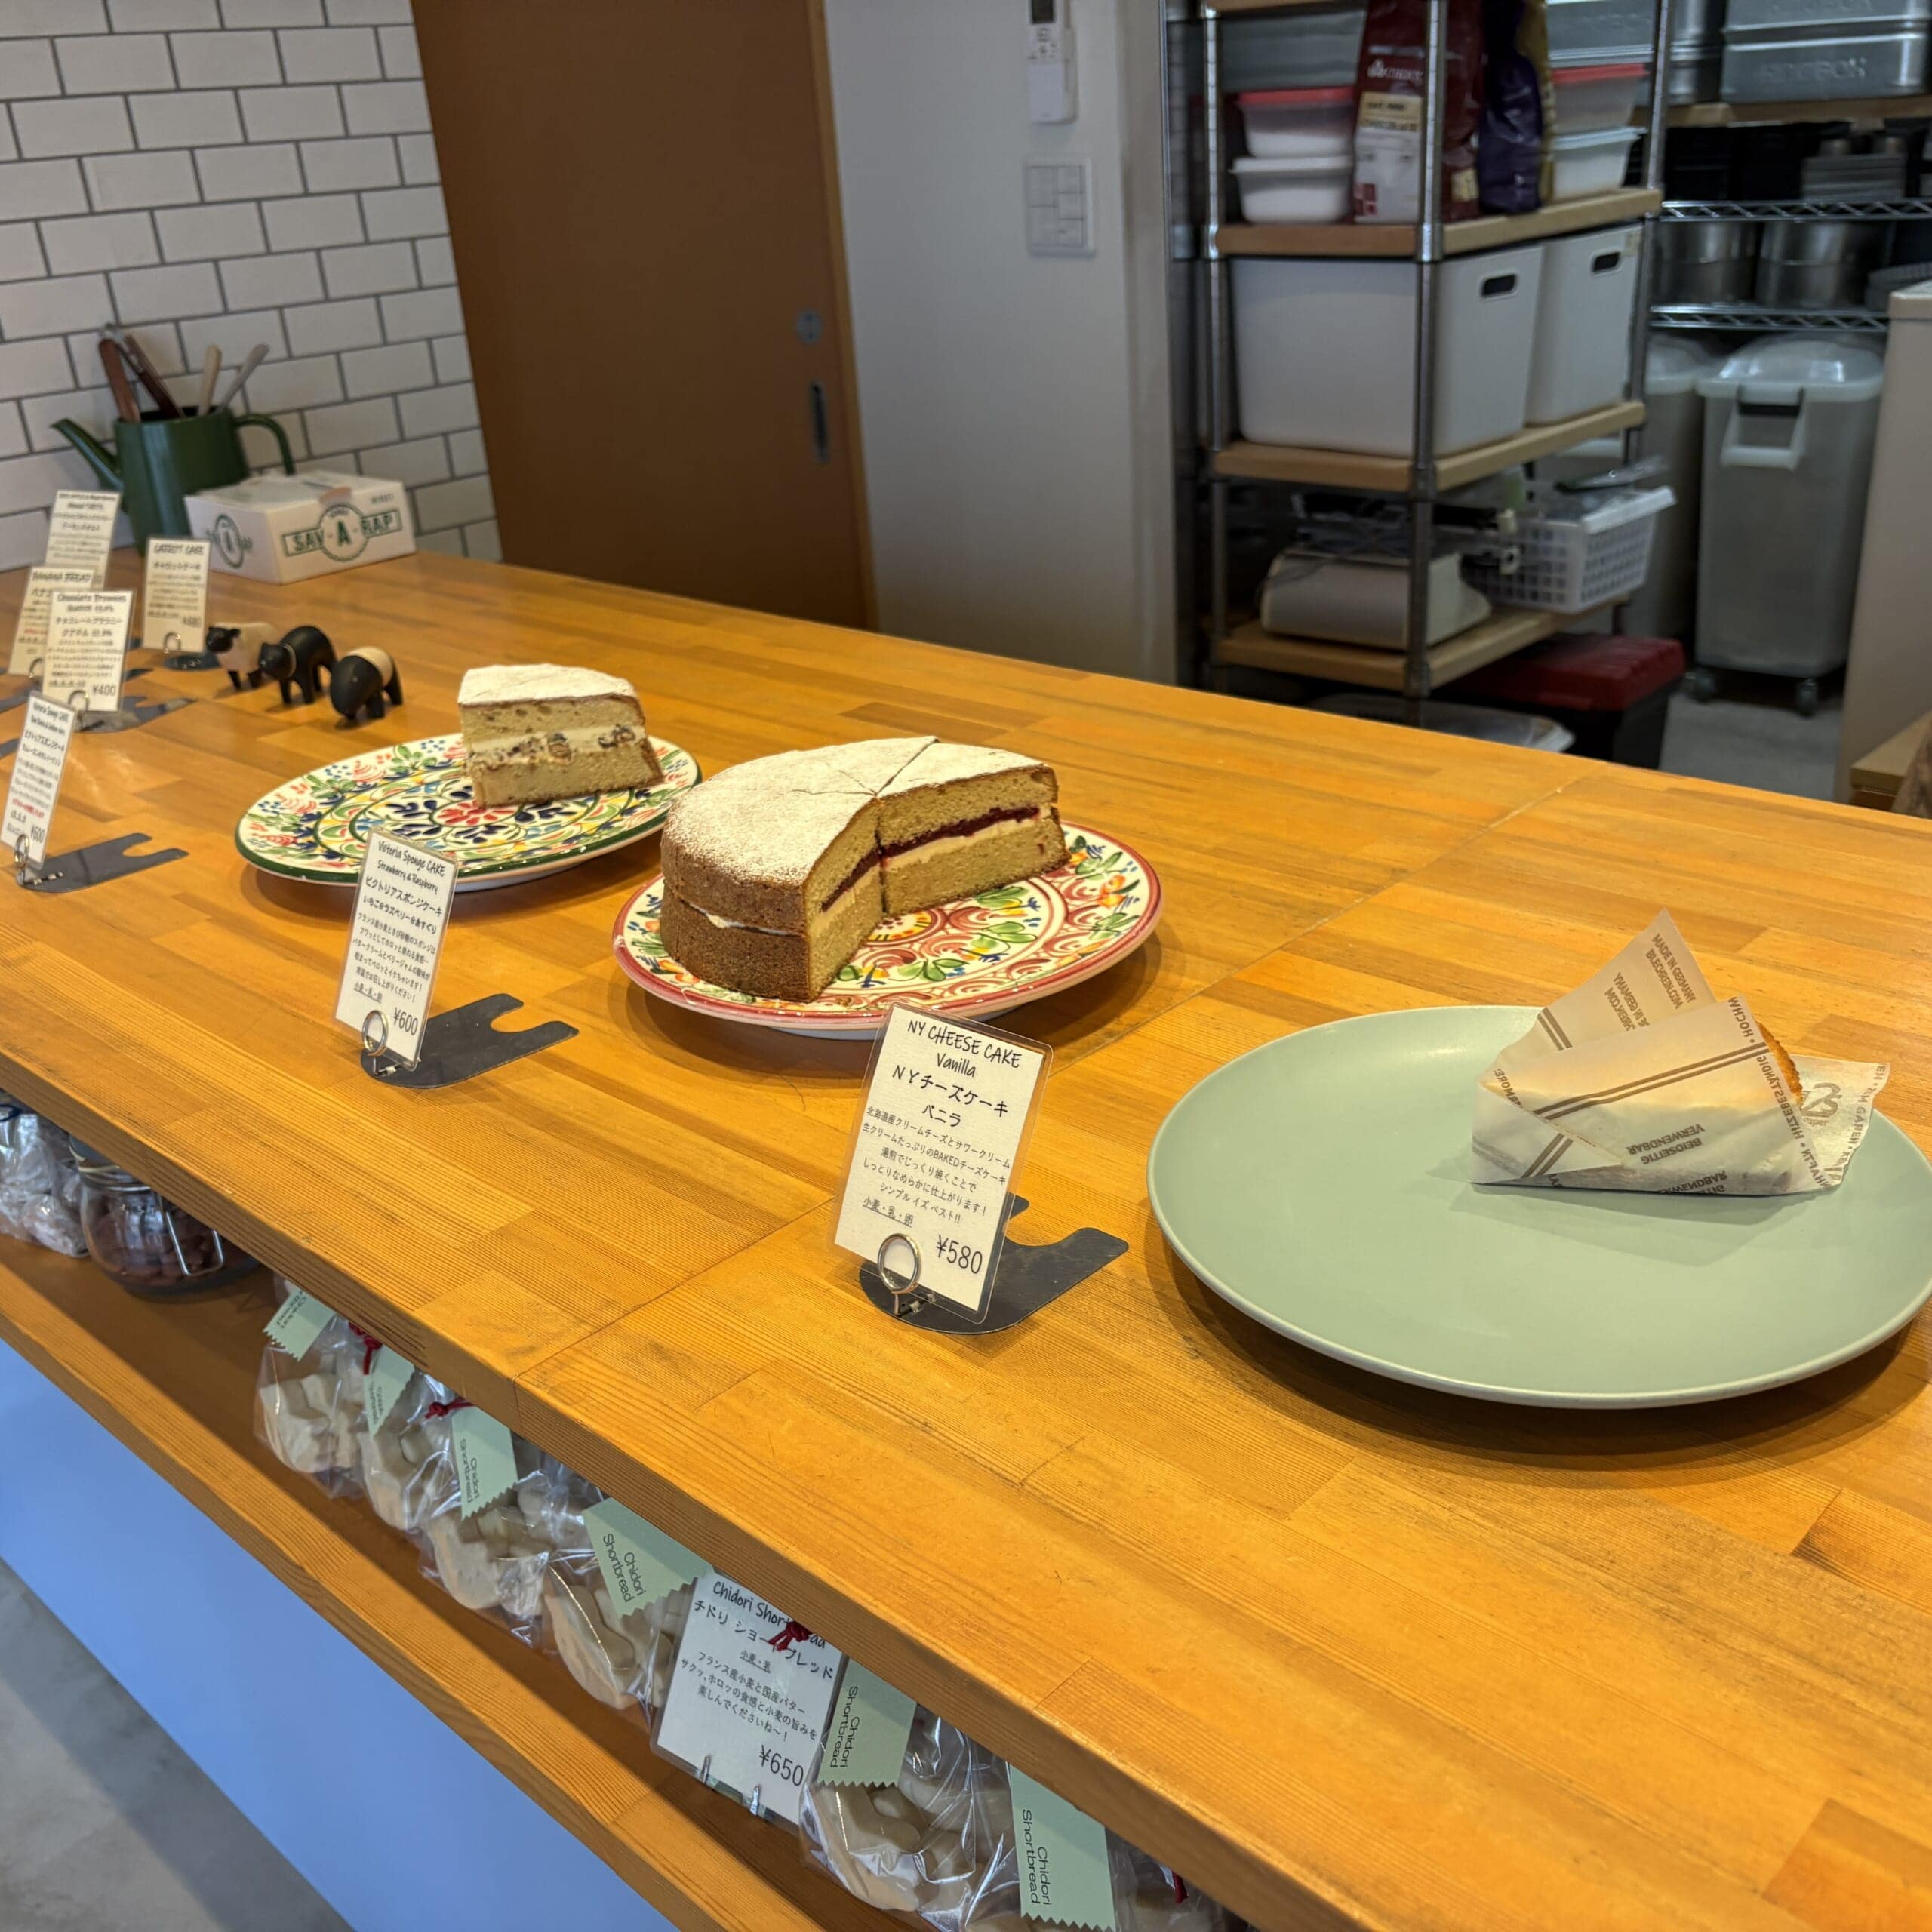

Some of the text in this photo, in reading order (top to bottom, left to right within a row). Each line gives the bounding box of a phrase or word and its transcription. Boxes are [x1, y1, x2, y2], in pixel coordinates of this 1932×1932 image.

[337, 521, 351, 546] A
[377, 860, 405, 878] Strawberry
[412, 875, 438, 893] Raspberry
[378, 841, 445, 875] Victoria Sponge CAKE
[365, 875, 442, 917] ビクトリアスポンジケーキ
[1652, 934, 1697, 1003] MADE IN GERMANY
[392, 1008, 418, 1035] ¥600
[907, 1020, 1022, 1068] NY CHEESE CAKE
[935, 1051, 977, 1076] Vanilla
[921, 1103, 961, 1127] バニラ
[863, 1124, 1006, 1185] 生クリームたっぷりのBAKEDチーズケーキ
[867, 1107, 1011, 1168] 北海道産クリームチーズとサワークリーム
[1626, 1124, 1706, 1155] VERWENDBAR
[1641, 1137, 1702, 1164] BEIDSEITIG
[881, 1148, 976, 1192] 湯煎でじっくり焼くことで
[934, 1235, 983, 1274] ¥580
[603, 1533, 635, 1602] Shortbread
[624, 1552, 647, 1596] Chidori
[694, 1599, 728, 1624] チドリ
[712, 1580, 752, 1610] Chidori
[699, 1652, 805, 1715] フランス産小麦と国産バター
[830, 1686, 858, 1767] Shortbread
[840, 1717, 860, 1767] Chidori
[758, 1744, 804, 1786] ¥650
[1023, 1810, 1041, 1903] Shortbread
[1038, 1847, 1051, 1905] Chidori
